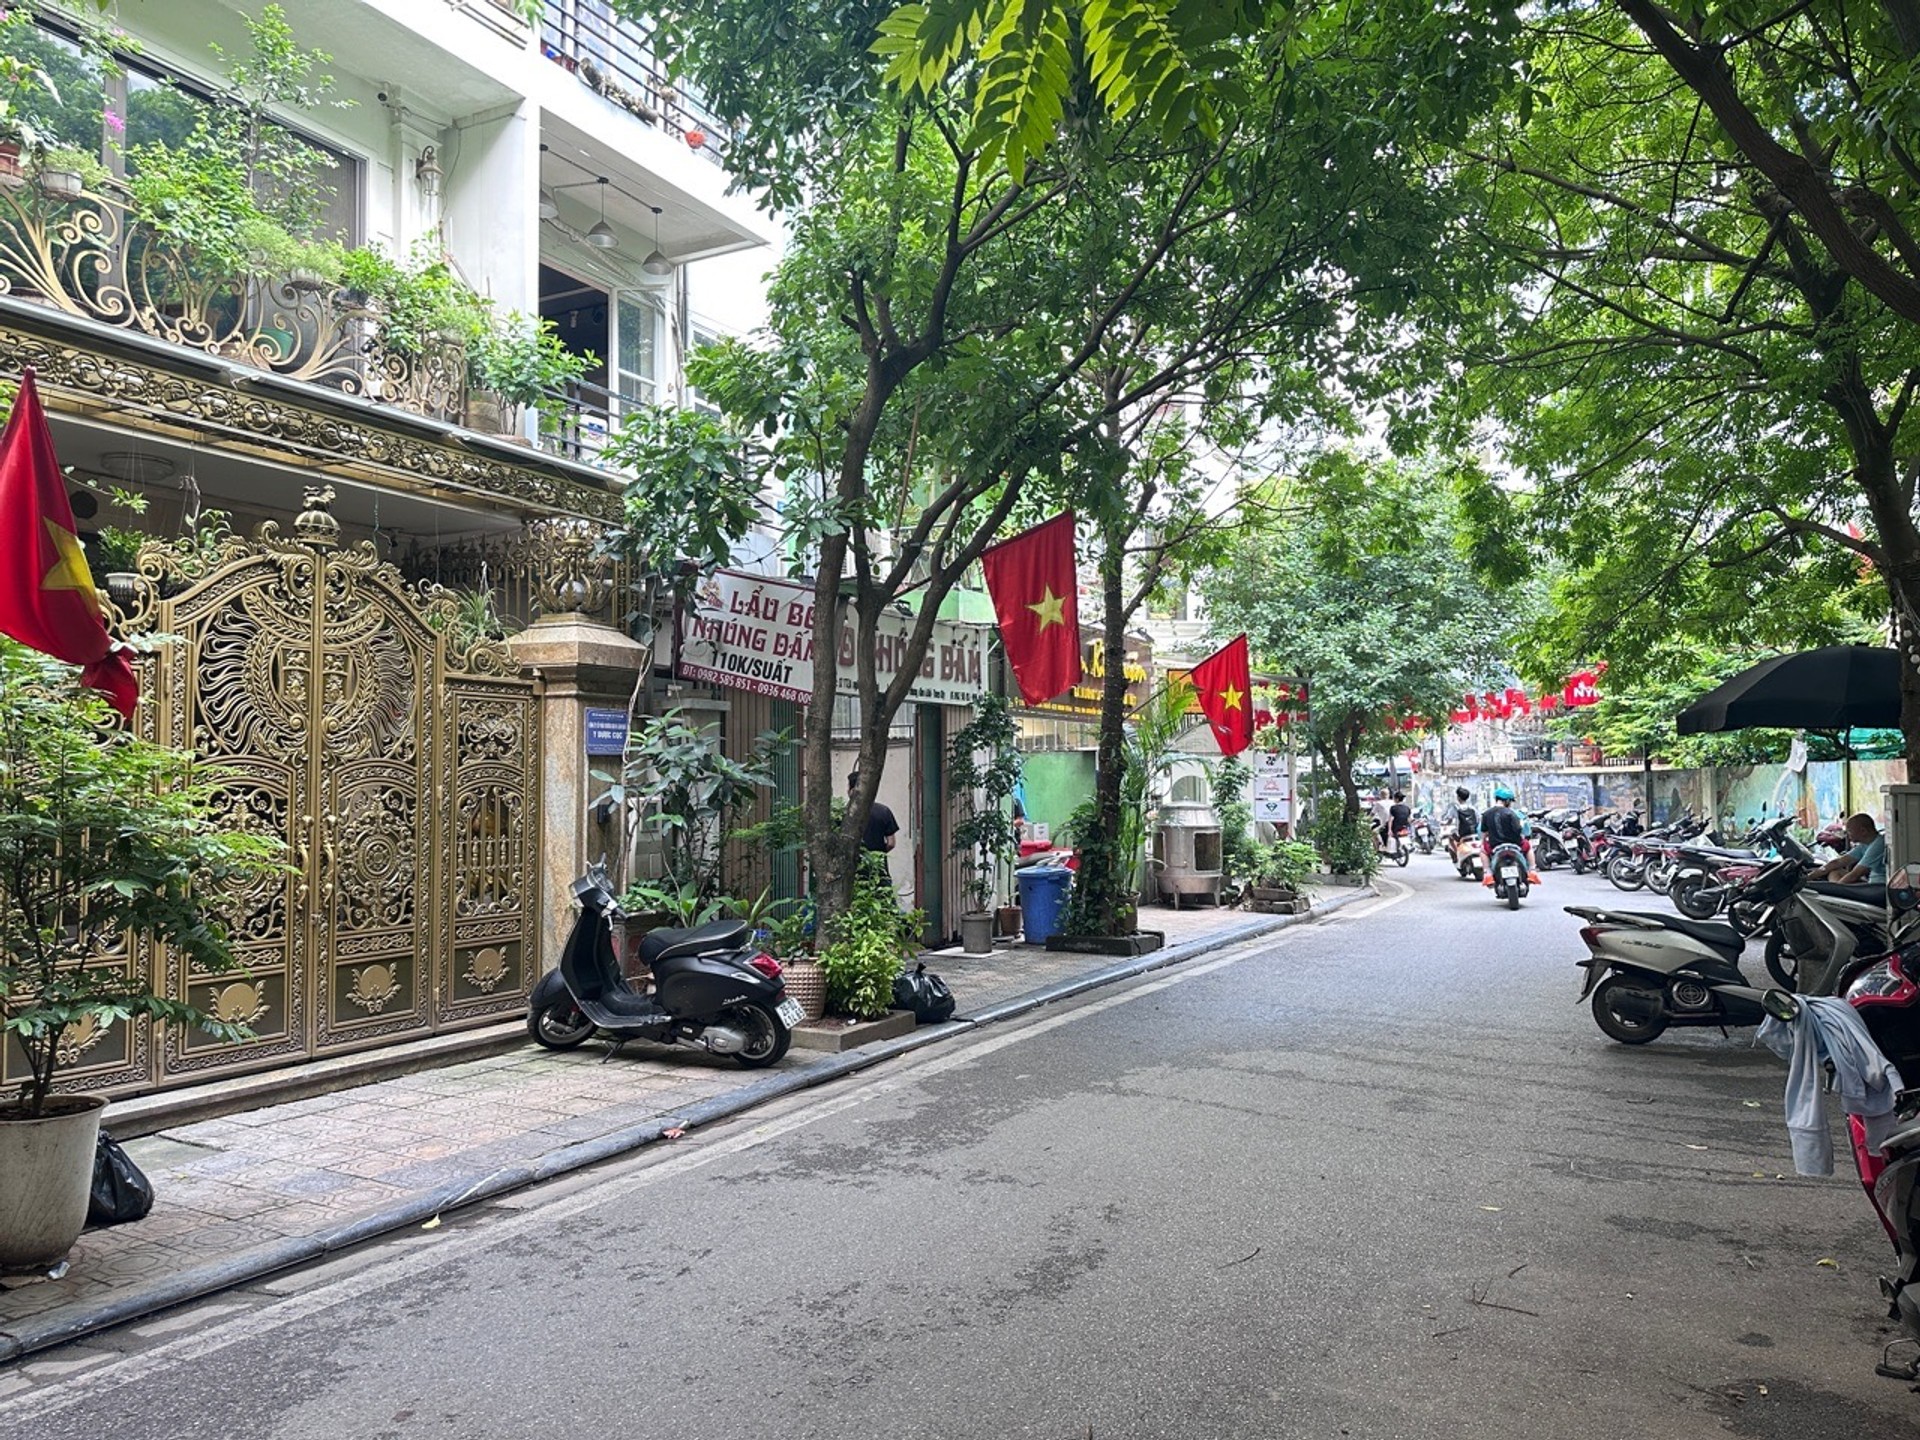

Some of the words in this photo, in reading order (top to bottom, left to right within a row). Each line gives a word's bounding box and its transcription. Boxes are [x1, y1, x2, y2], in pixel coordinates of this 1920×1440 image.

[729, 585, 780, 622] LẨU
[692, 618, 768, 652] NHÚNG
[682, 665, 697, 677] ĐT:
[697, 668, 717, 682] 0982
[757, 682, 779, 696] 0936
[712, 650, 793, 684] 110K/SUẤT
